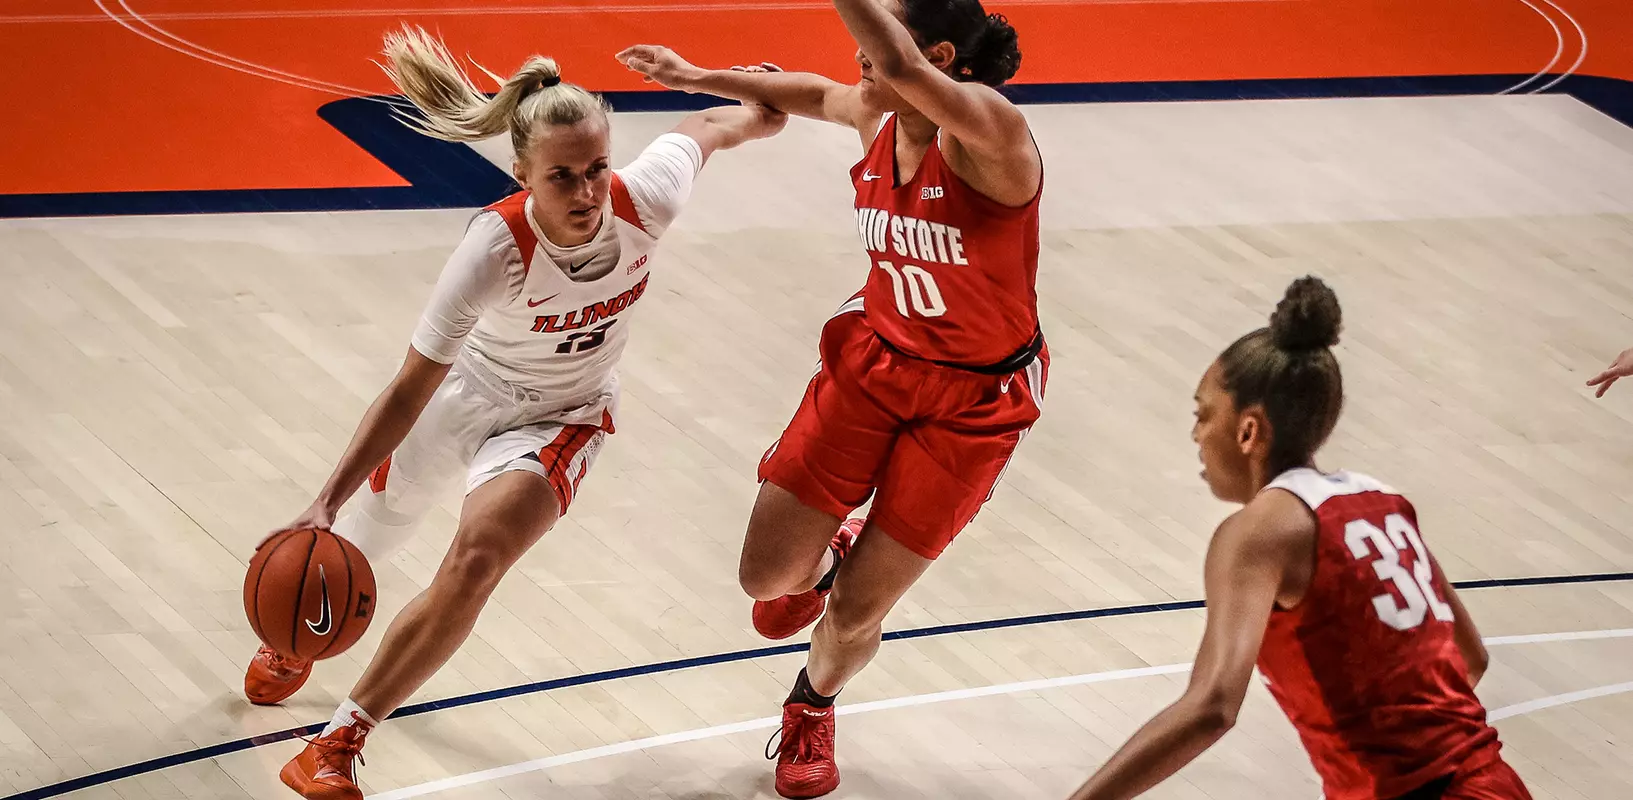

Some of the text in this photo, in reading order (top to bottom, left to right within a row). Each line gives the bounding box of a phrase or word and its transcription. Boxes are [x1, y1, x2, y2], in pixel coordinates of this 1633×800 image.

[855, 207, 969, 266] HIO STATE
[529, 271, 651, 333] ILLINOIS
[877, 260, 948, 319] 10
[1343, 512, 1455, 632] 32
